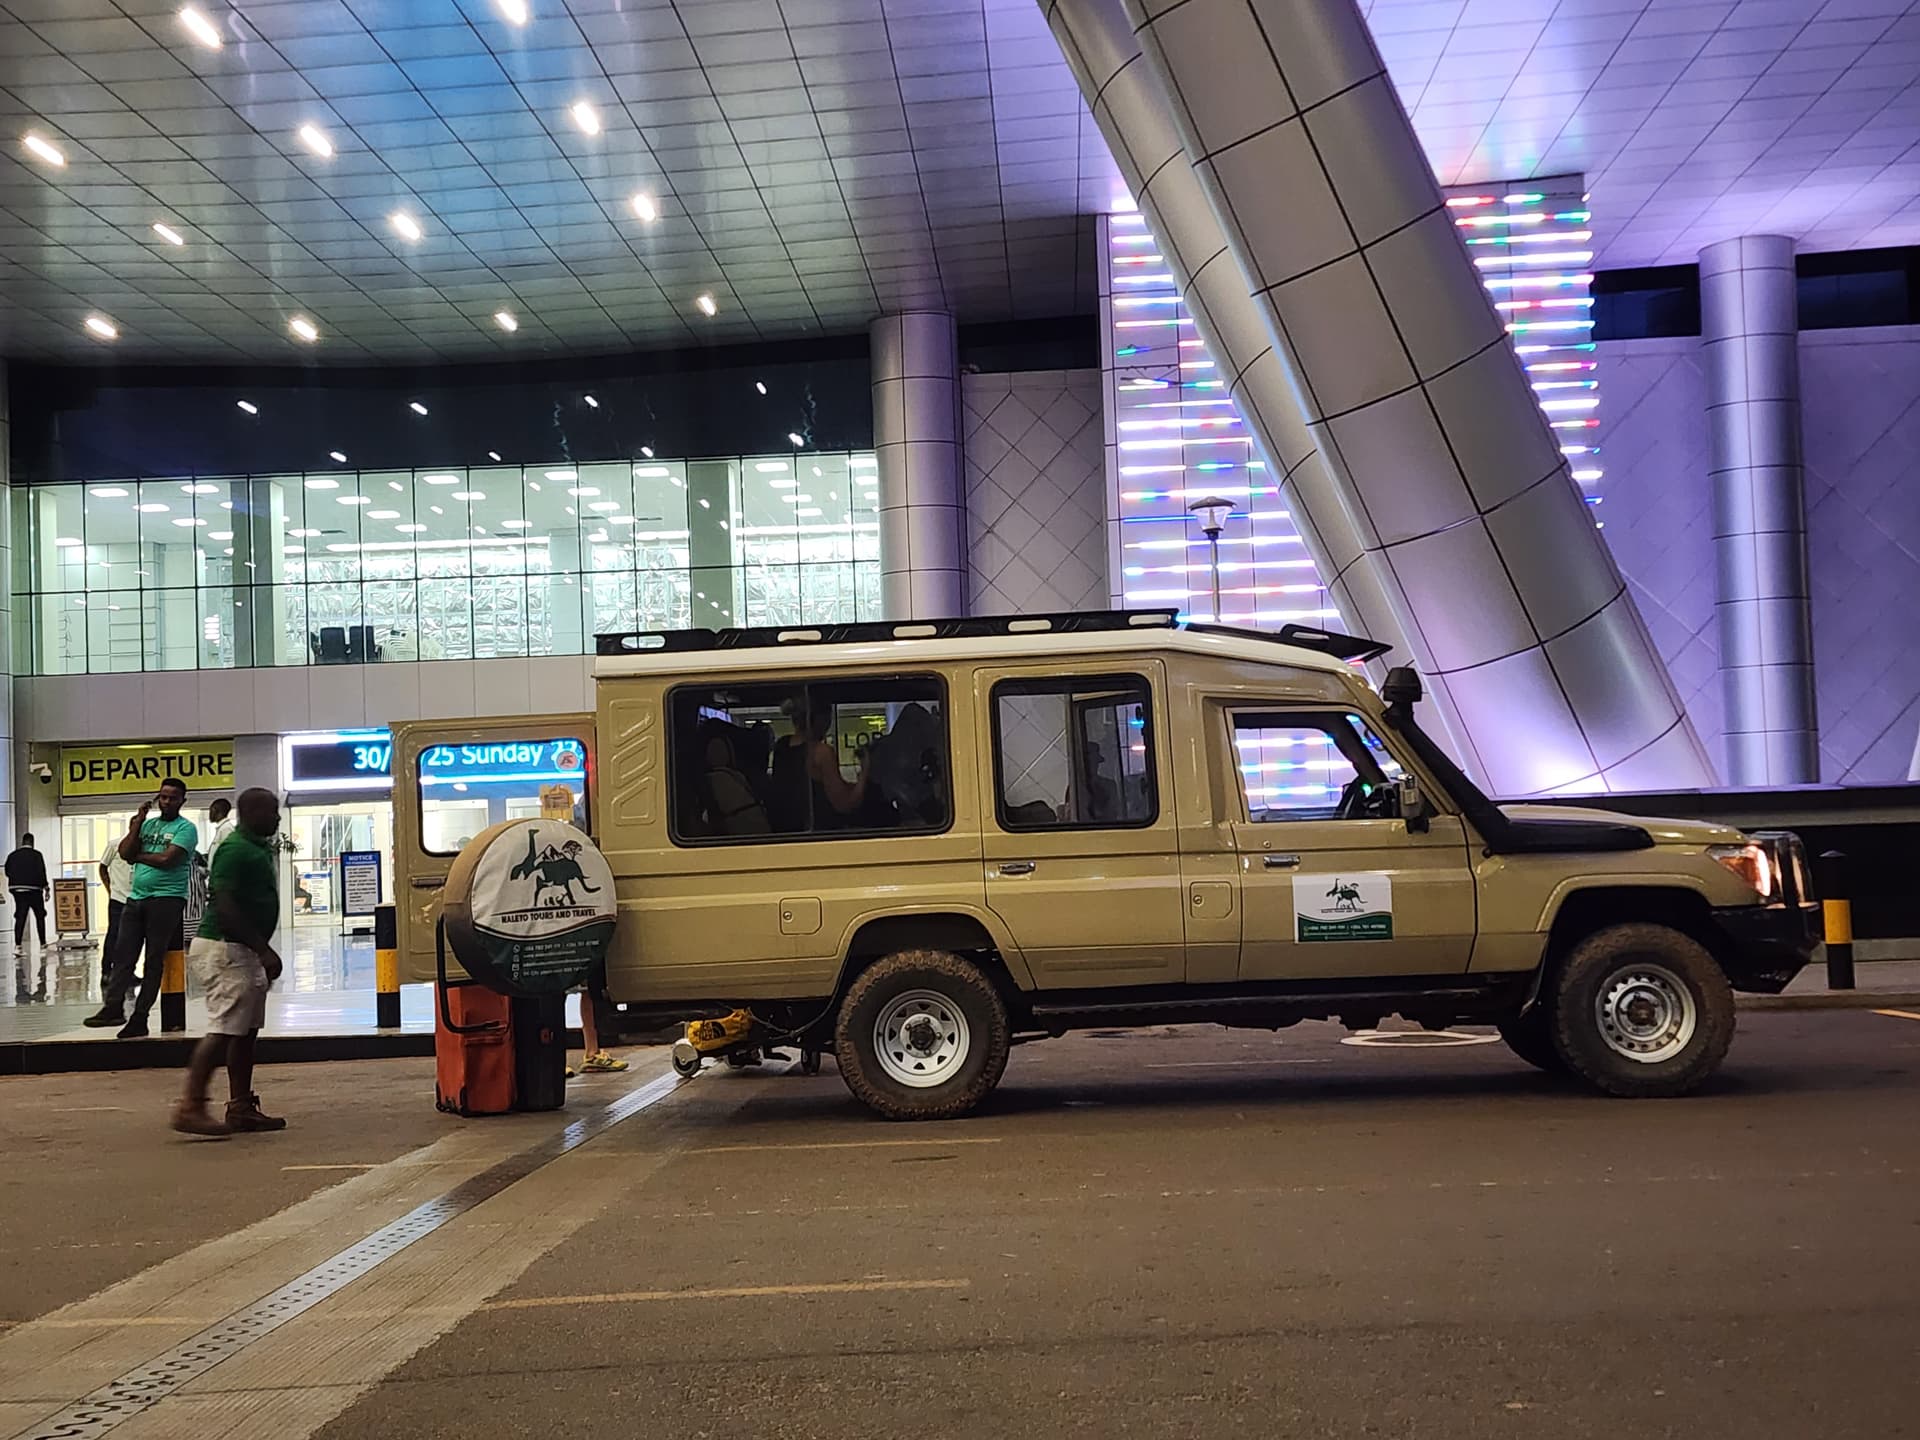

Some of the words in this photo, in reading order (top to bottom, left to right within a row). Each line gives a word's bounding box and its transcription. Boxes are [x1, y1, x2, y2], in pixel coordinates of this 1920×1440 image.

[461, 743, 544, 767] Sunday
[69, 753, 233, 783] DEPARTURE
[530, 912, 554, 921] TOURS
[555, 910, 571, 919] AND
[572, 908, 597, 918] TRAVEL
